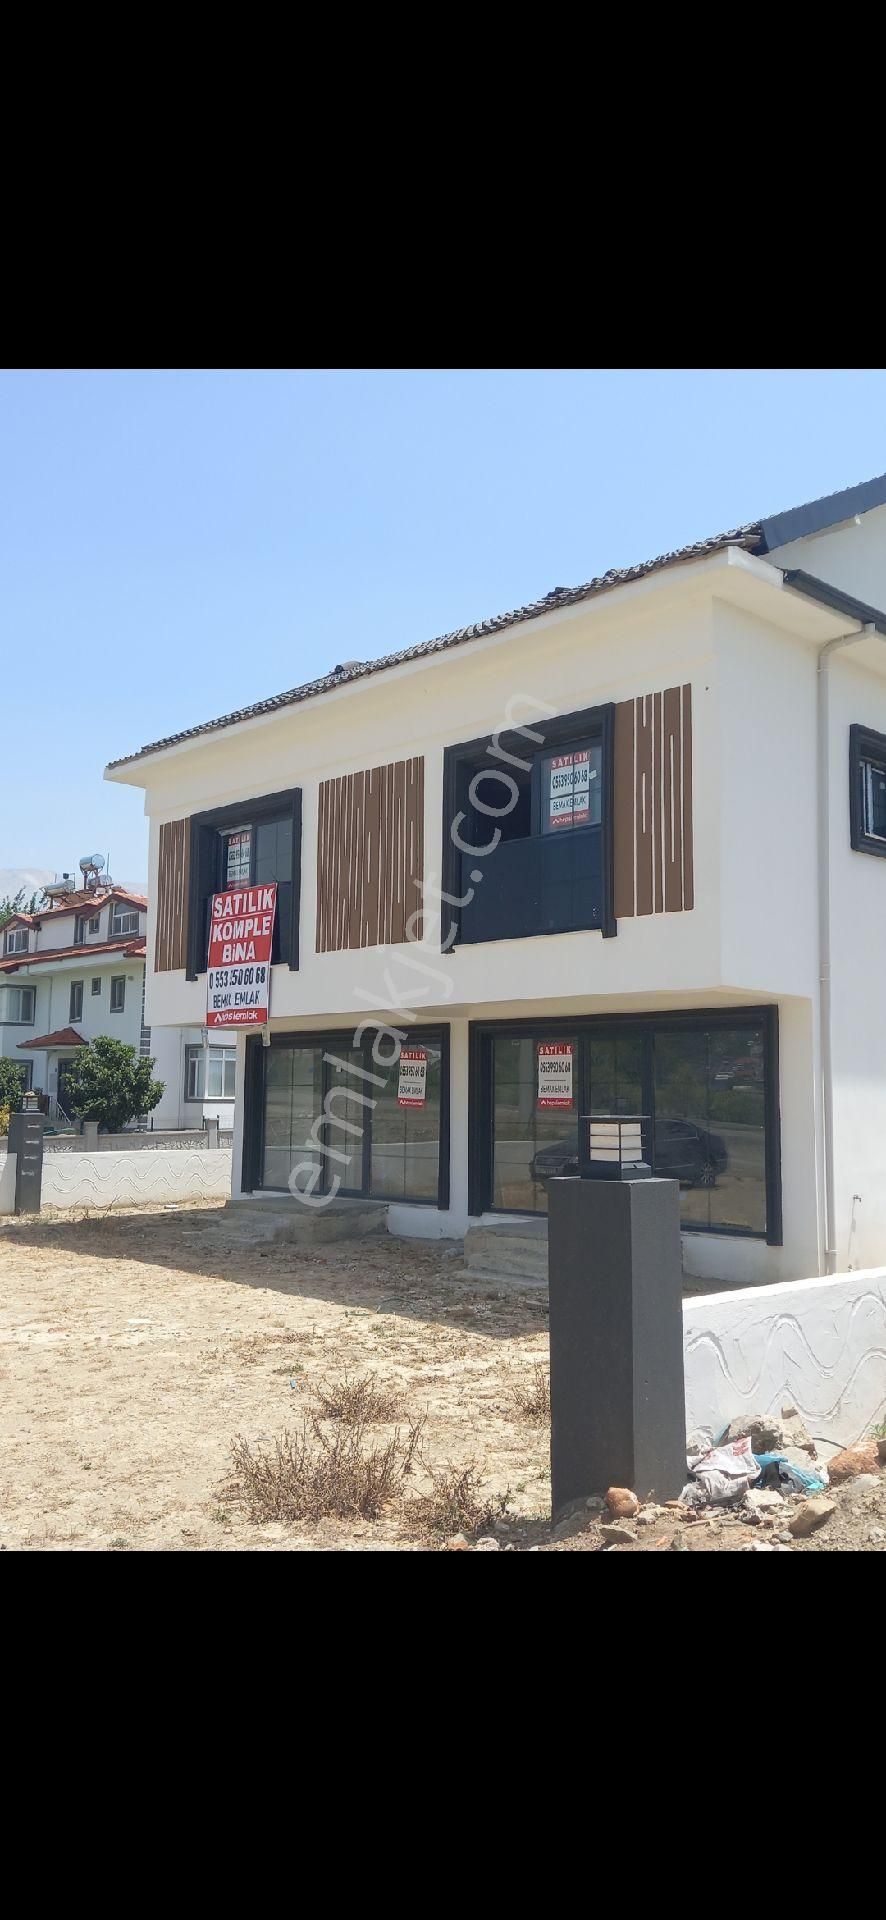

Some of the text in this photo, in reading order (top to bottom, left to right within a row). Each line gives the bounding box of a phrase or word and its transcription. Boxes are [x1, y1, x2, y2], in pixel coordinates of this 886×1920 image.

[552, 752, 588, 768] SATILIK
[214, 888, 275, 918] SATILIK
[212, 915, 272, 943] KOMPLE
[209, 972, 214, 990] 0
[215, 970, 229, 989] 553
[255, 966, 266, 984] 68
[234, 990, 260, 1006] EMLAK
[400, 1051, 426, 1060] SATILIK
[540, 1045, 572, 1055] SATILIK
